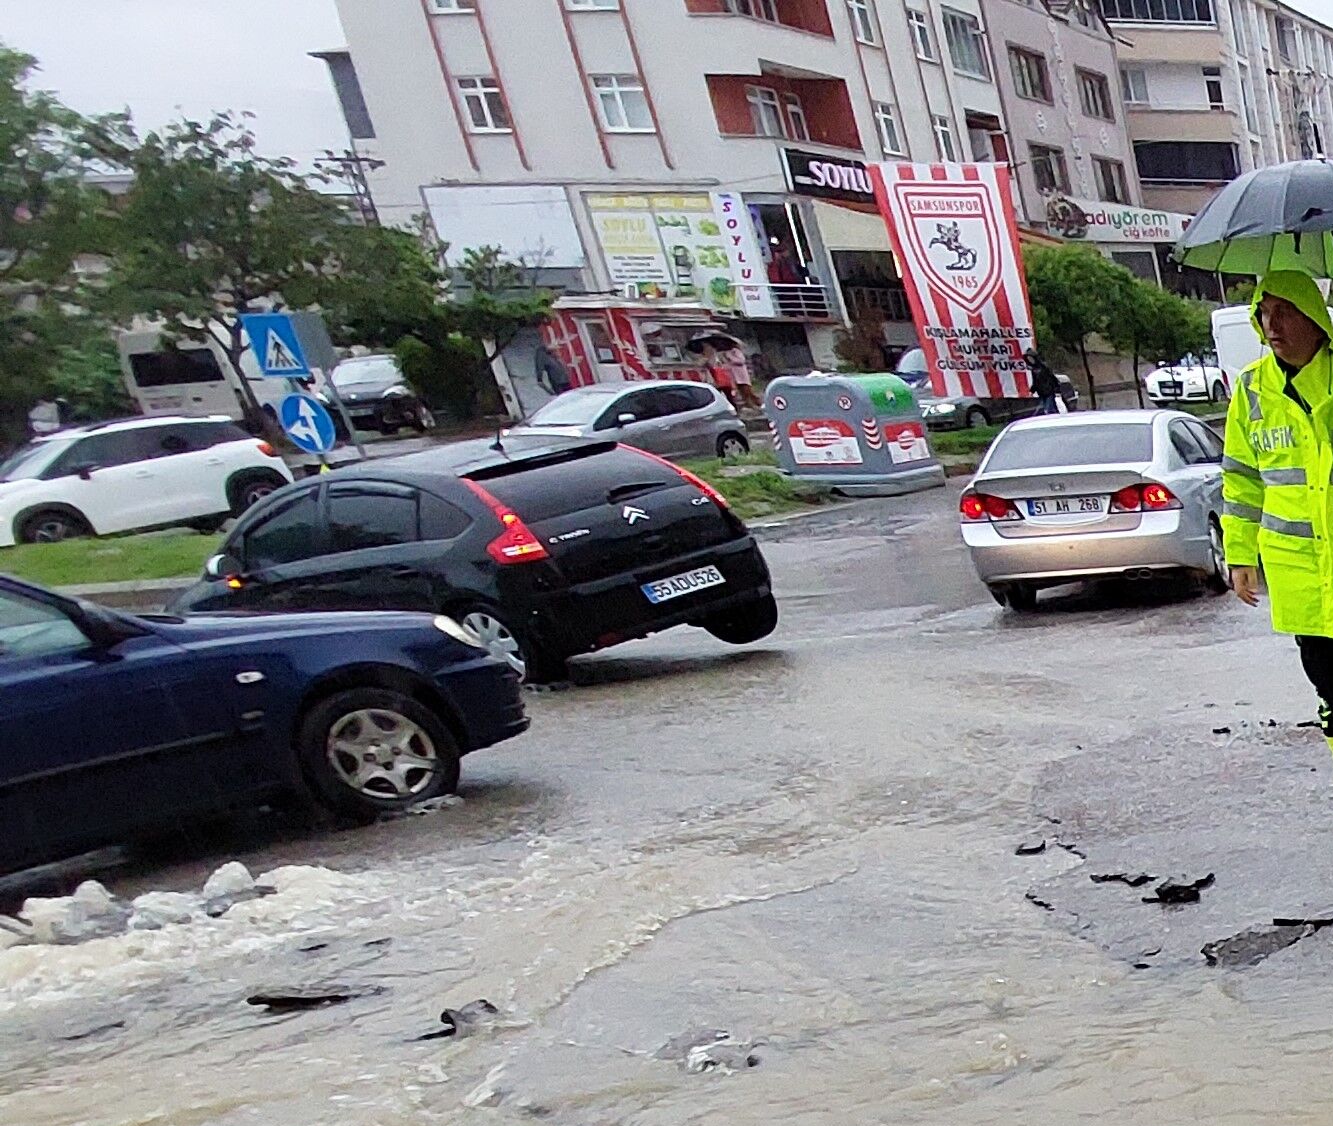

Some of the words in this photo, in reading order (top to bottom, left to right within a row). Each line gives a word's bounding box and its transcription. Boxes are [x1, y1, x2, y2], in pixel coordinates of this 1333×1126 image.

[910, 200, 980, 212] SAMSUNSPOR
[1085, 210, 1168, 229] adıyörem
[1142, 226, 1170, 238] köfte
[722, 202, 752, 280] SOYLU
[953, 275, 979, 289] 1965
[952, 344, 1013, 355] MUHTARI
[938, 358, 987, 371] GÜLSÜM
[1251, 425, 1297, 452] RAFİK
[1034, 501, 1047, 514] 51
[1056, 501, 1070, 512] AH
[1079, 498, 1099, 511] 268
